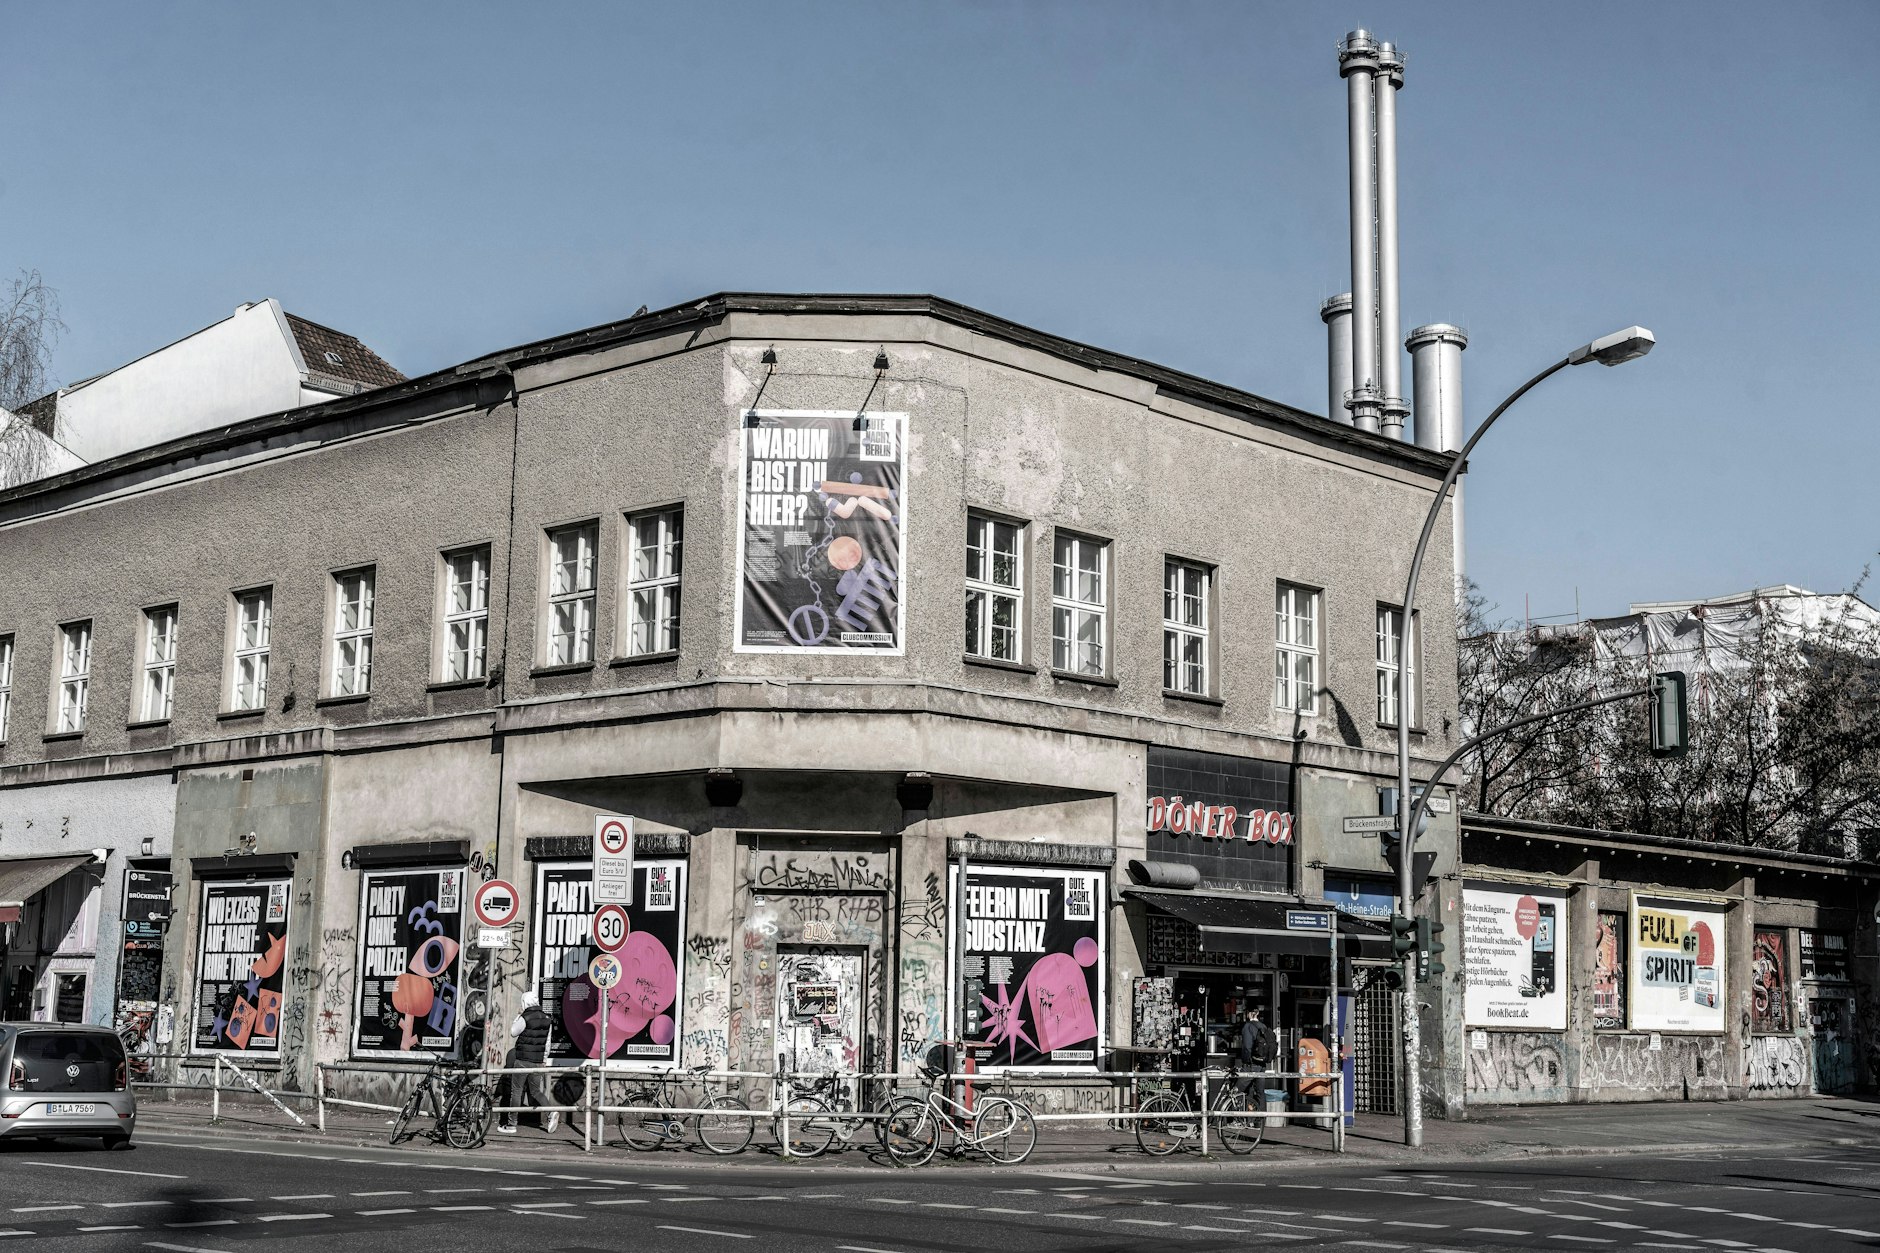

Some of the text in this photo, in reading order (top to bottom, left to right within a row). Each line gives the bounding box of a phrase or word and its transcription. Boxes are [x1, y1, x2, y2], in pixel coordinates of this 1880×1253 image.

[752, 428, 829, 460] WARUM
[866, 444, 891, 457] BERLIN
[751, 460, 828, 492] BIST DU
[750, 494, 808, 526] HIER?
[842, 634, 892, 642] CLUBCOMMISSION
[1148, 796, 1298, 846] DÖNER BOX
[1348, 819, 1392, 828] Brückenstraße
[602, 860, 616, 868] Diesel
[651, 867, 667, 880] GUTE
[650, 880, 672, 894] NACHT,
[1069, 877, 1084, 890] GUTE
[128, 886, 170, 900] BRÜCKENSTR. 1
[1069, 890, 1090, 904] NACHT,
[1350, 883, 1359, 900] U
[369, 886, 406, 916] PARTY
[650, 894, 671, 906] BERLIN
[1018, 888, 1050, 920] MIT
[208, 896, 261, 924] WO EXZESS
[1069, 904, 1090, 916] BERLIN
[1335, 902, 1392, 916] ch-Heine-Straße
[1472, 904, 1483, 912] dem
[1484, 904, 1505, 916] Känguru
[1479, 916, 1498, 924] putzen,
[368, 917, 398, 946] OHNE
[546, 914, 596, 946] UTOPI
[601, 917, 621, 938] 30
[1471, 924, 1487, 933] Arbeit
[1488, 926, 1504, 936] gehen,
[1640, 914, 1679, 944] FULL
[205, 924, 260, 952] AUF NACHT-
[1472, 935, 1494, 944] Haushalt
[1495, 937, 1522, 946] schmeißen,
[1683, 935, 1697, 952] OF
[1478, 946, 1492, 956] Spree
[1492, 948, 1516, 957] spazieren,
[204, 953, 230, 980] RUHE
[365, 947, 408, 976] POLIZEI
[544, 946, 590, 978] BLICK
[1466, 956, 1491, 964] nschlafen.
[1481, 967, 1508, 976] Hörbücher
[1646, 956, 1695, 984] SPIRIT
[1469, 977, 1512, 988] jeden Augenblick.
[1487, 1008, 1529, 1018] BookBeat.de
